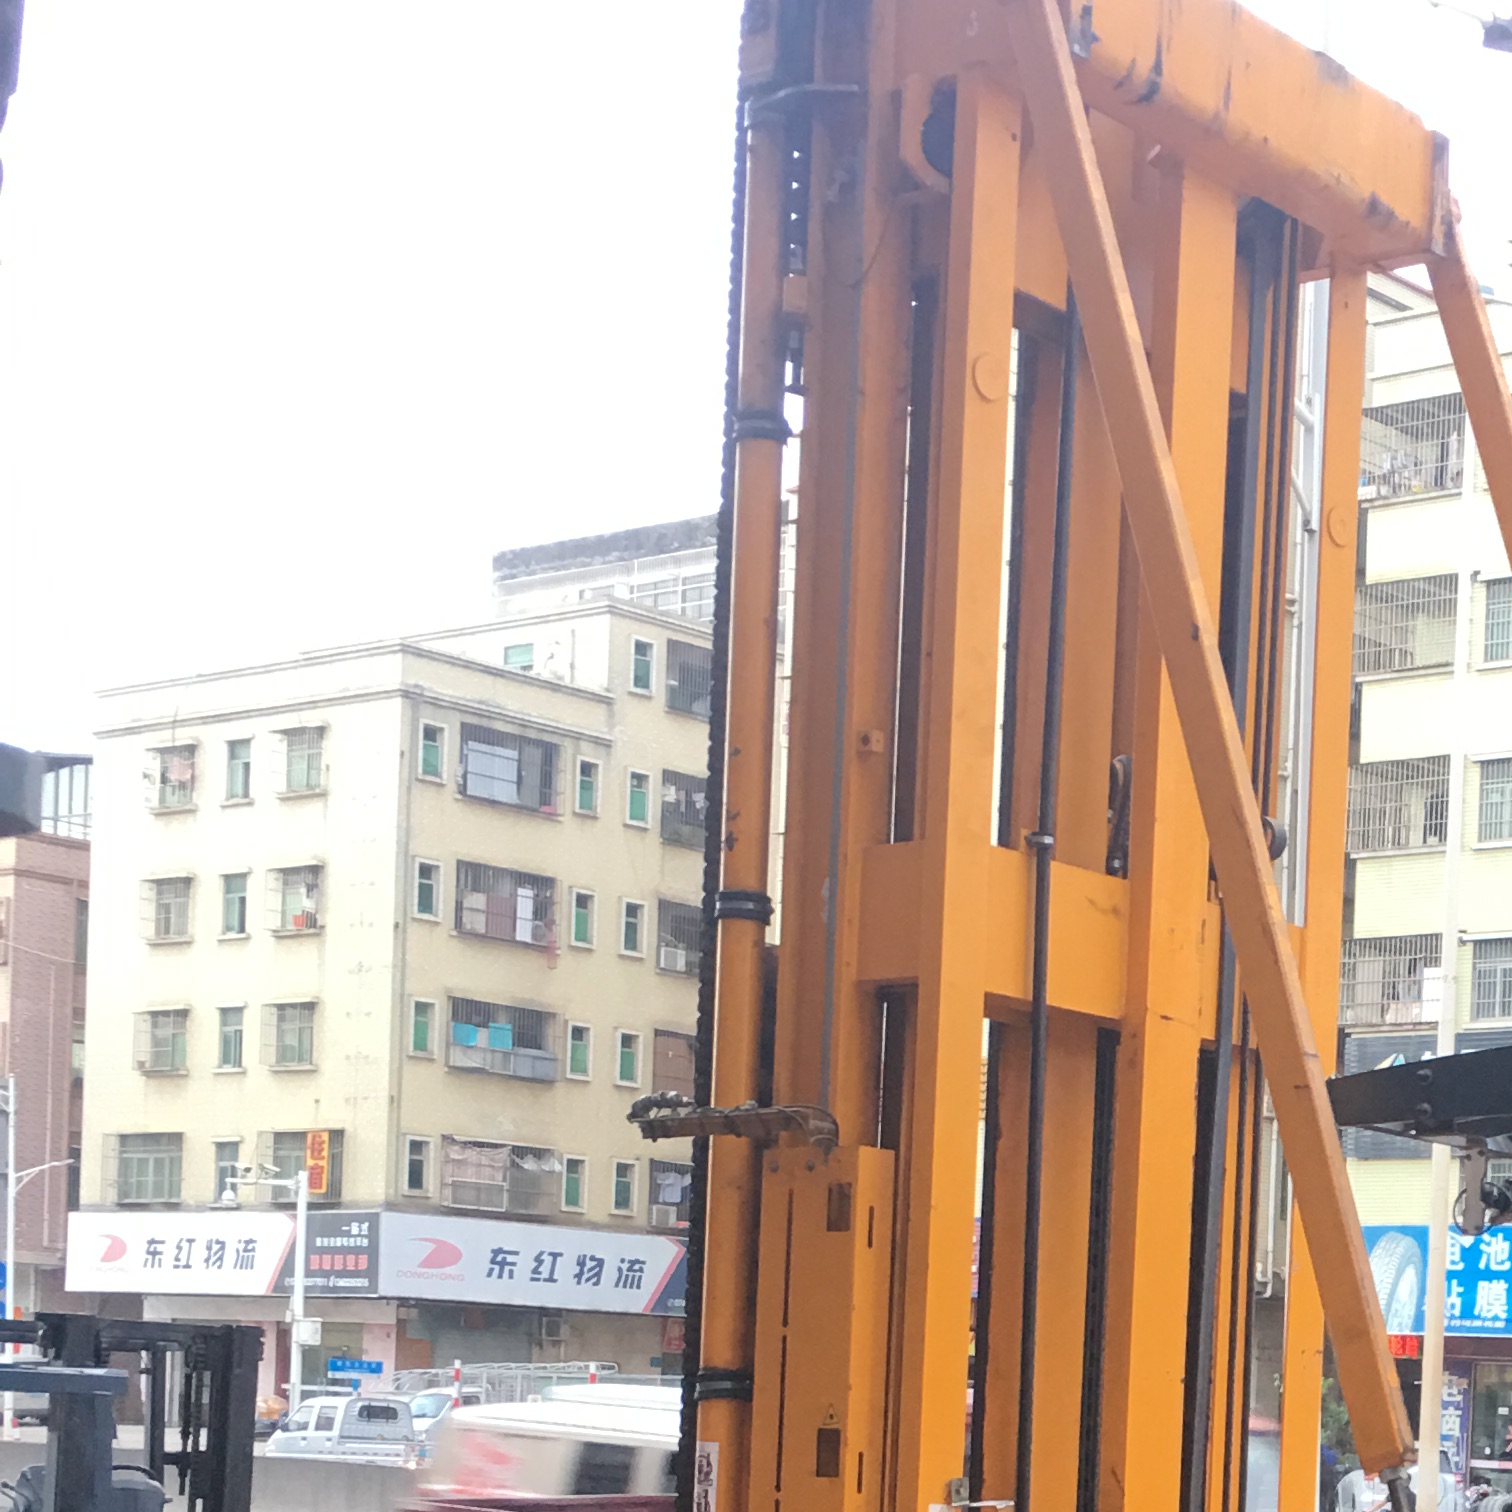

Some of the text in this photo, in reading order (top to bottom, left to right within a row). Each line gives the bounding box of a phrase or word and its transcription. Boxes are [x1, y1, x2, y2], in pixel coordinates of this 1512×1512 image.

[143, 1237, 258, 1271] 东红物流
[486, 1246, 647, 1291] 东红物流
[396, 1269, 465, 1283] DONGHONG
